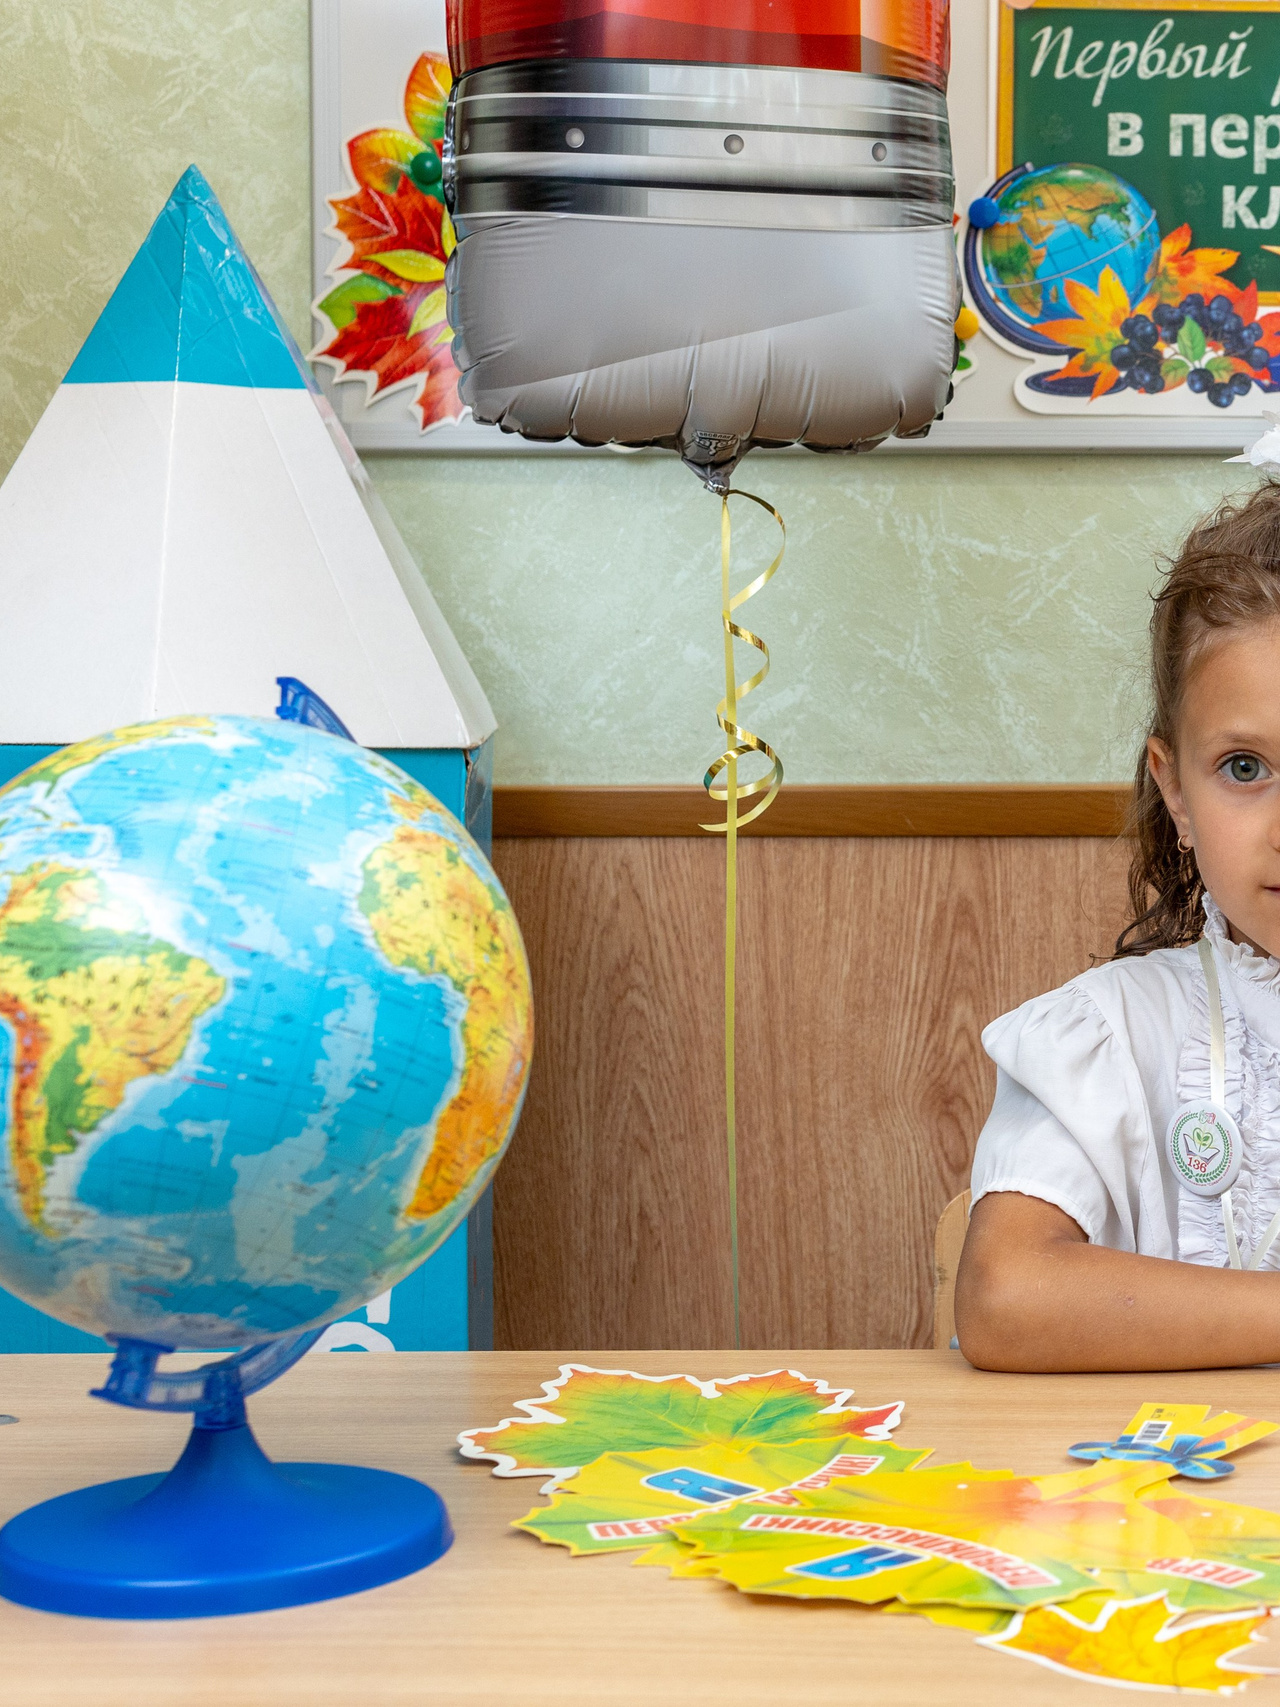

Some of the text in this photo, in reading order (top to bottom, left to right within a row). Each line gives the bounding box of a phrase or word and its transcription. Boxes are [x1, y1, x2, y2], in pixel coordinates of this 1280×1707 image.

[1030, 18, 1252, 107] Первый
[1106, 112, 1143, 156] в
[1187, 1157, 1207, 1173] 136
[643, 1469, 758, 1503] Я
[748, 1516, 1054, 1587] ПЕРВОКЛАССНИК!
[788, 1546, 924, 1578] Я
